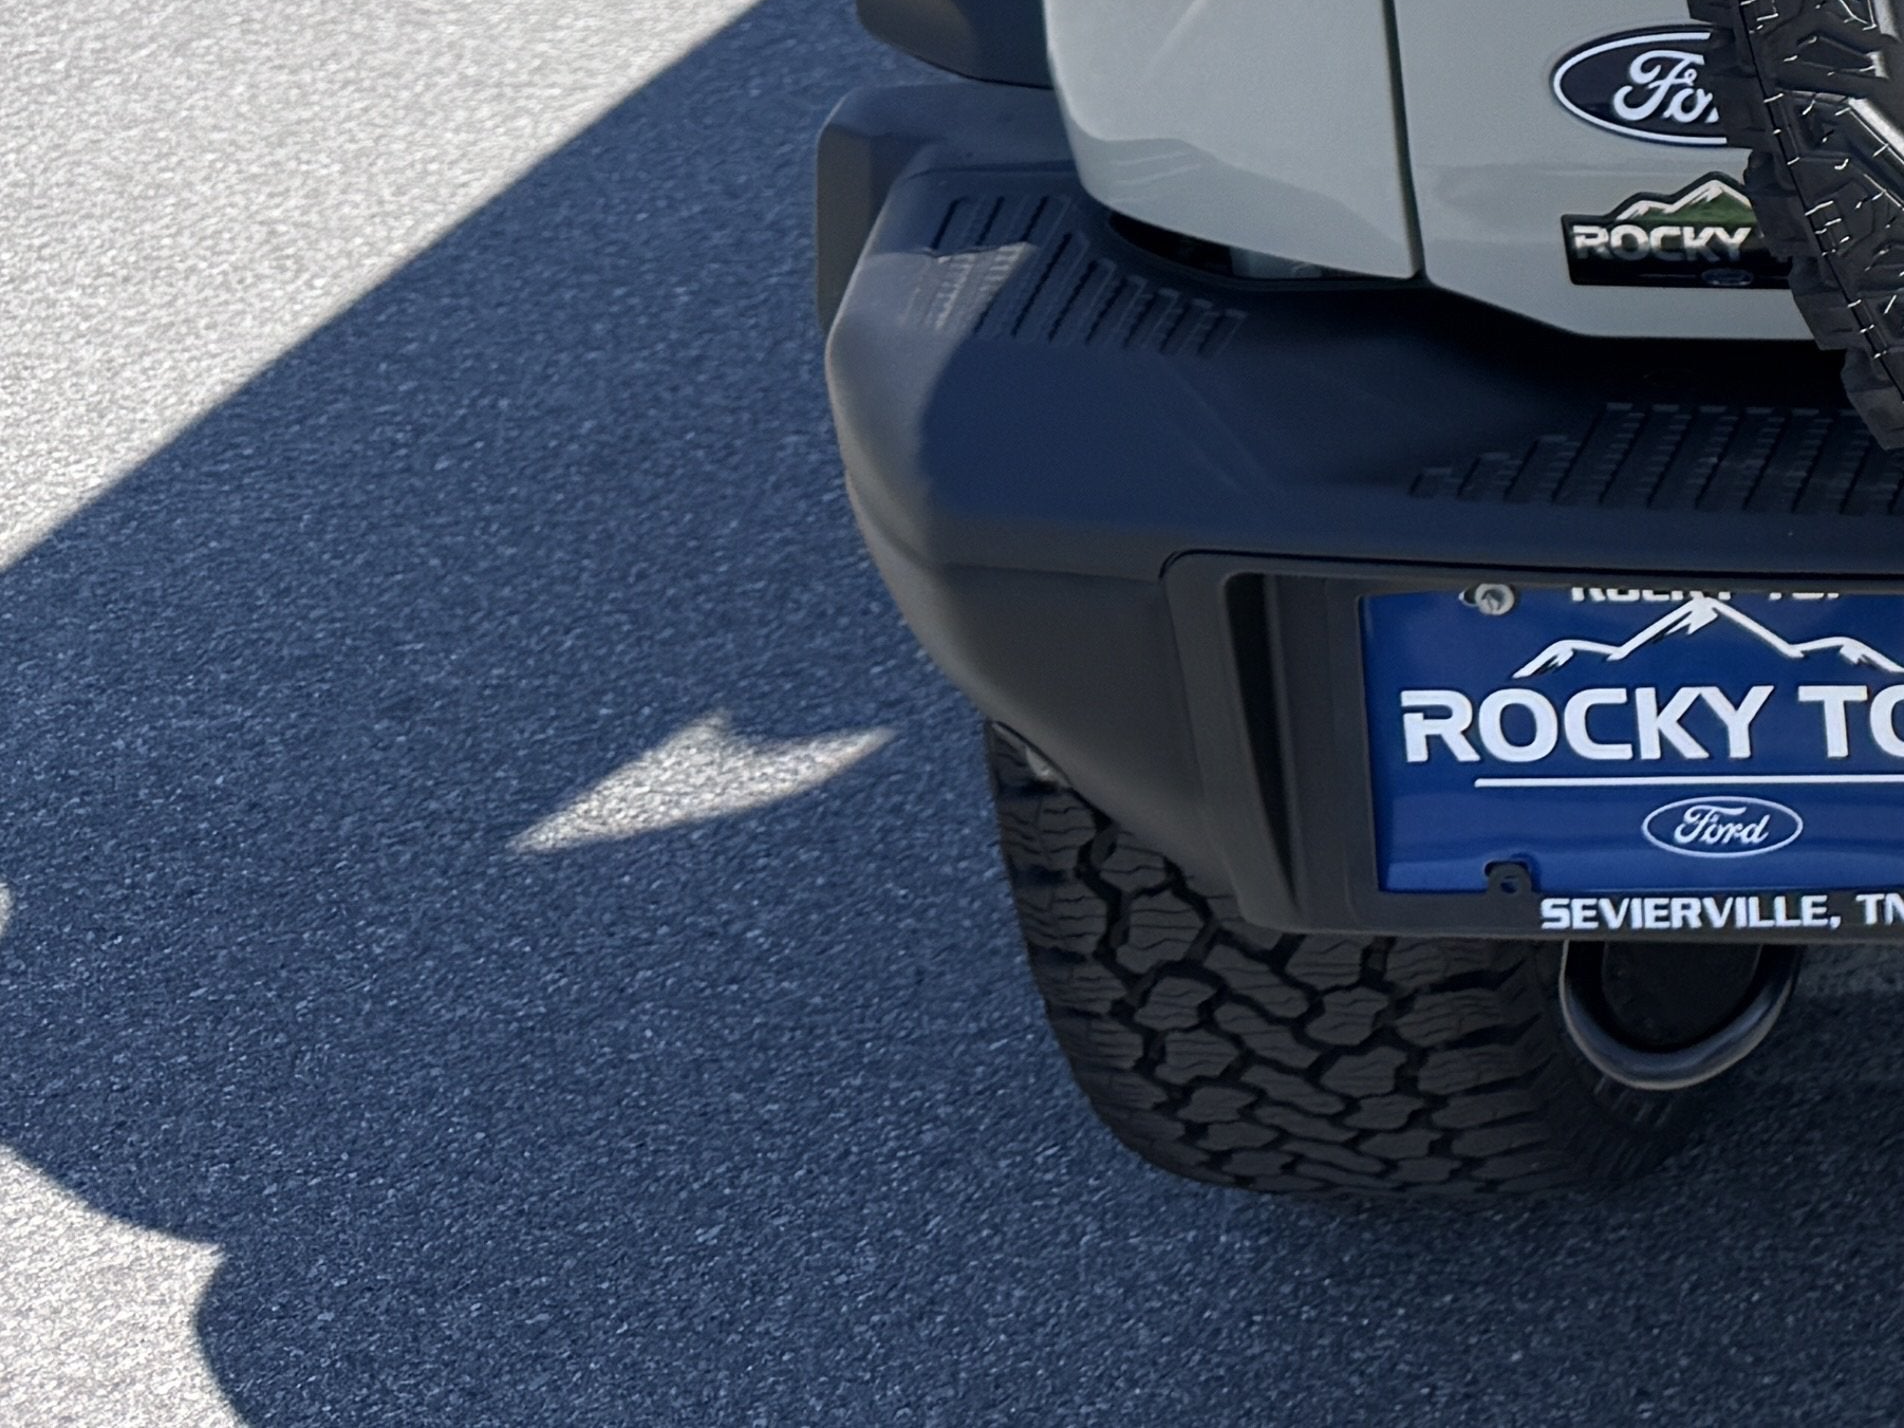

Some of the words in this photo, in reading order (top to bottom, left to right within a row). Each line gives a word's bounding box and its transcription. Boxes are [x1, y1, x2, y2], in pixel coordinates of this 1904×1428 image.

[1572, 224, 1752, 263] ROCKY
[1400, 683, 1776, 764] ROCKY
[1673, 804, 1771, 849] Ford
[1540, 894, 1842, 932] SEVIERVILLE,
